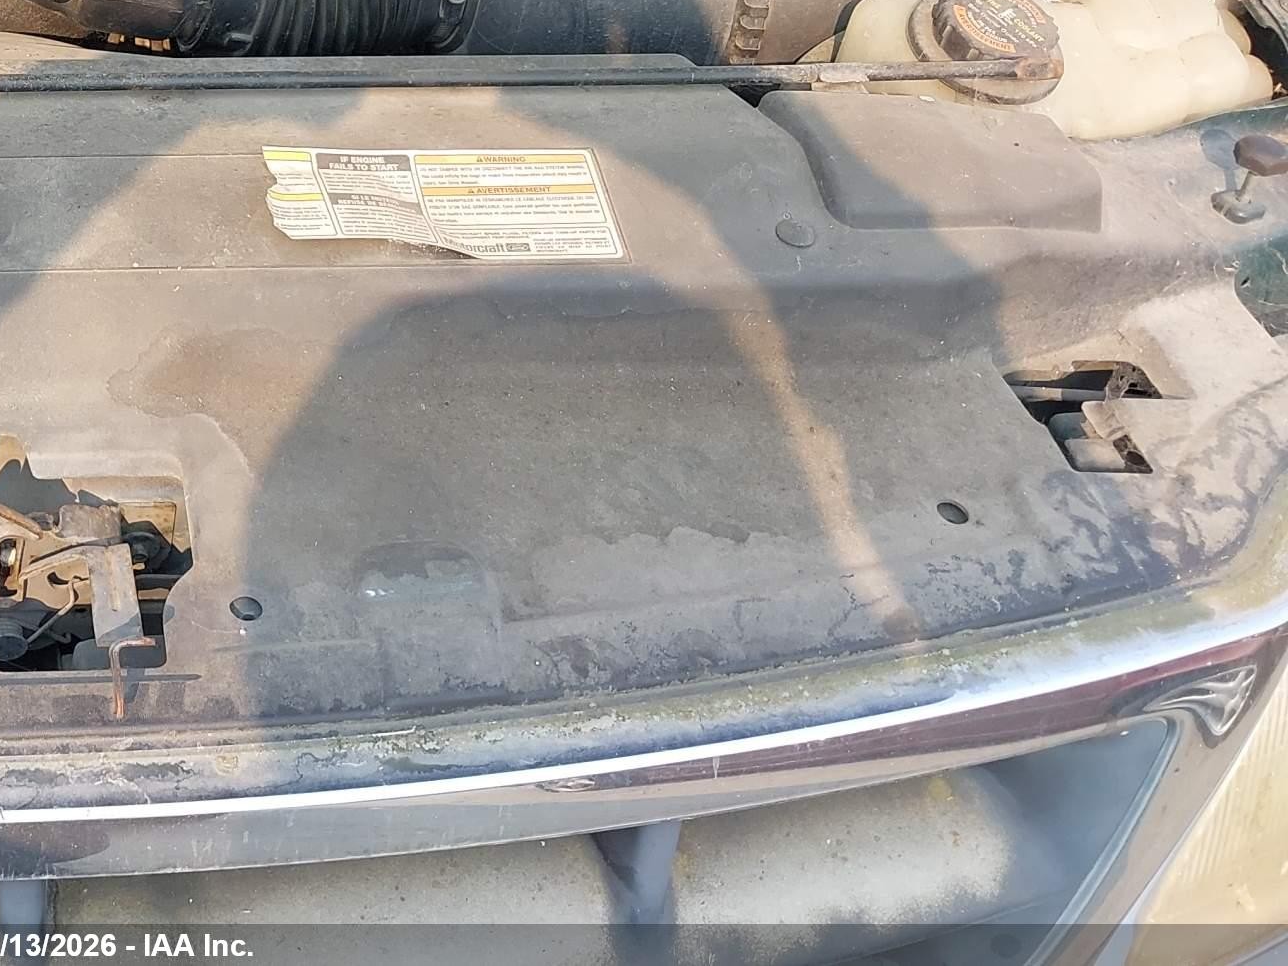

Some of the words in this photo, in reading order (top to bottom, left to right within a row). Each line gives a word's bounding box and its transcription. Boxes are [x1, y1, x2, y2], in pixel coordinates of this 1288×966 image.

[1014, 17, 1046, 43] COOLANT
[339, 156, 349, 164] IF
[350, 156, 385, 164] ENGINE
[328, 162, 354, 170] FAILS
[355, 163, 367, 171] TO
[370, 163, 400, 171] START
[476, 186, 551, 194] AVERTISSEMENT
